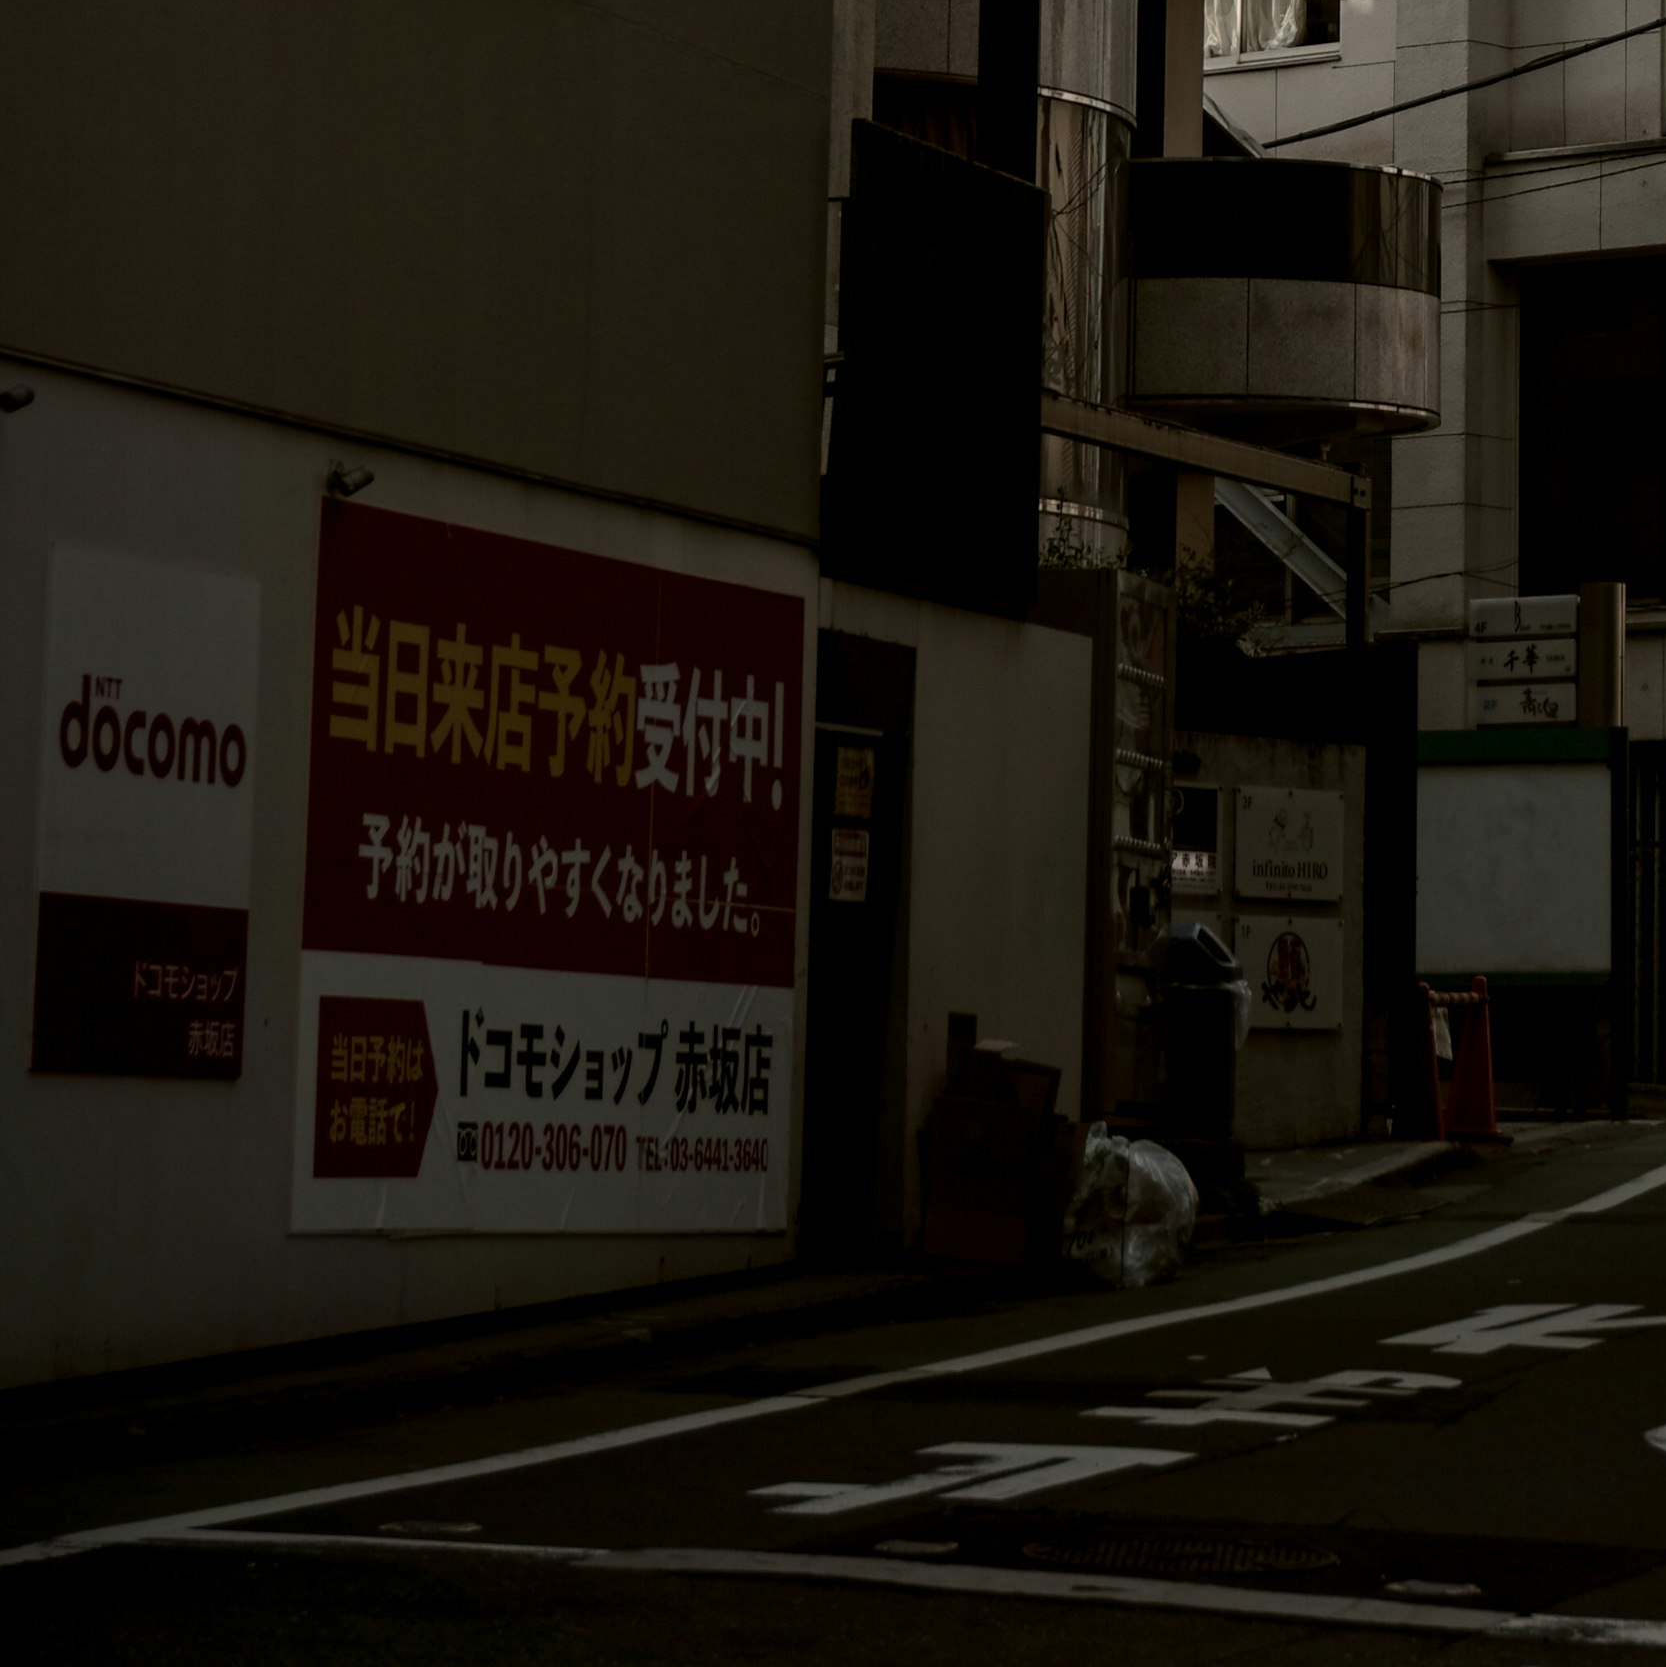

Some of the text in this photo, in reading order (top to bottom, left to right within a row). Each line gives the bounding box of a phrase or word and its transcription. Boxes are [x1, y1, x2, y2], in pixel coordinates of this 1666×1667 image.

[95, 676, 122, 700] NTT
[328, 604, 785, 812] 当日来店予約受付中!
[60, 674, 245, 787] docomo
[358, 812, 760, 937] 予約が取りやすくなりました。
[1297, 861, 1328, 880] HIRO
[134, 960, 238, 1003] ドコモショップ
[187, 1020, 235, 1059] 赤坂店
[330, 1034, 423, 1084] 当日予約は
[459, 1008, 772, 1116] ドコモショップ 赤坂店
[480, 1122, 627, 1172] 0120-306-070
